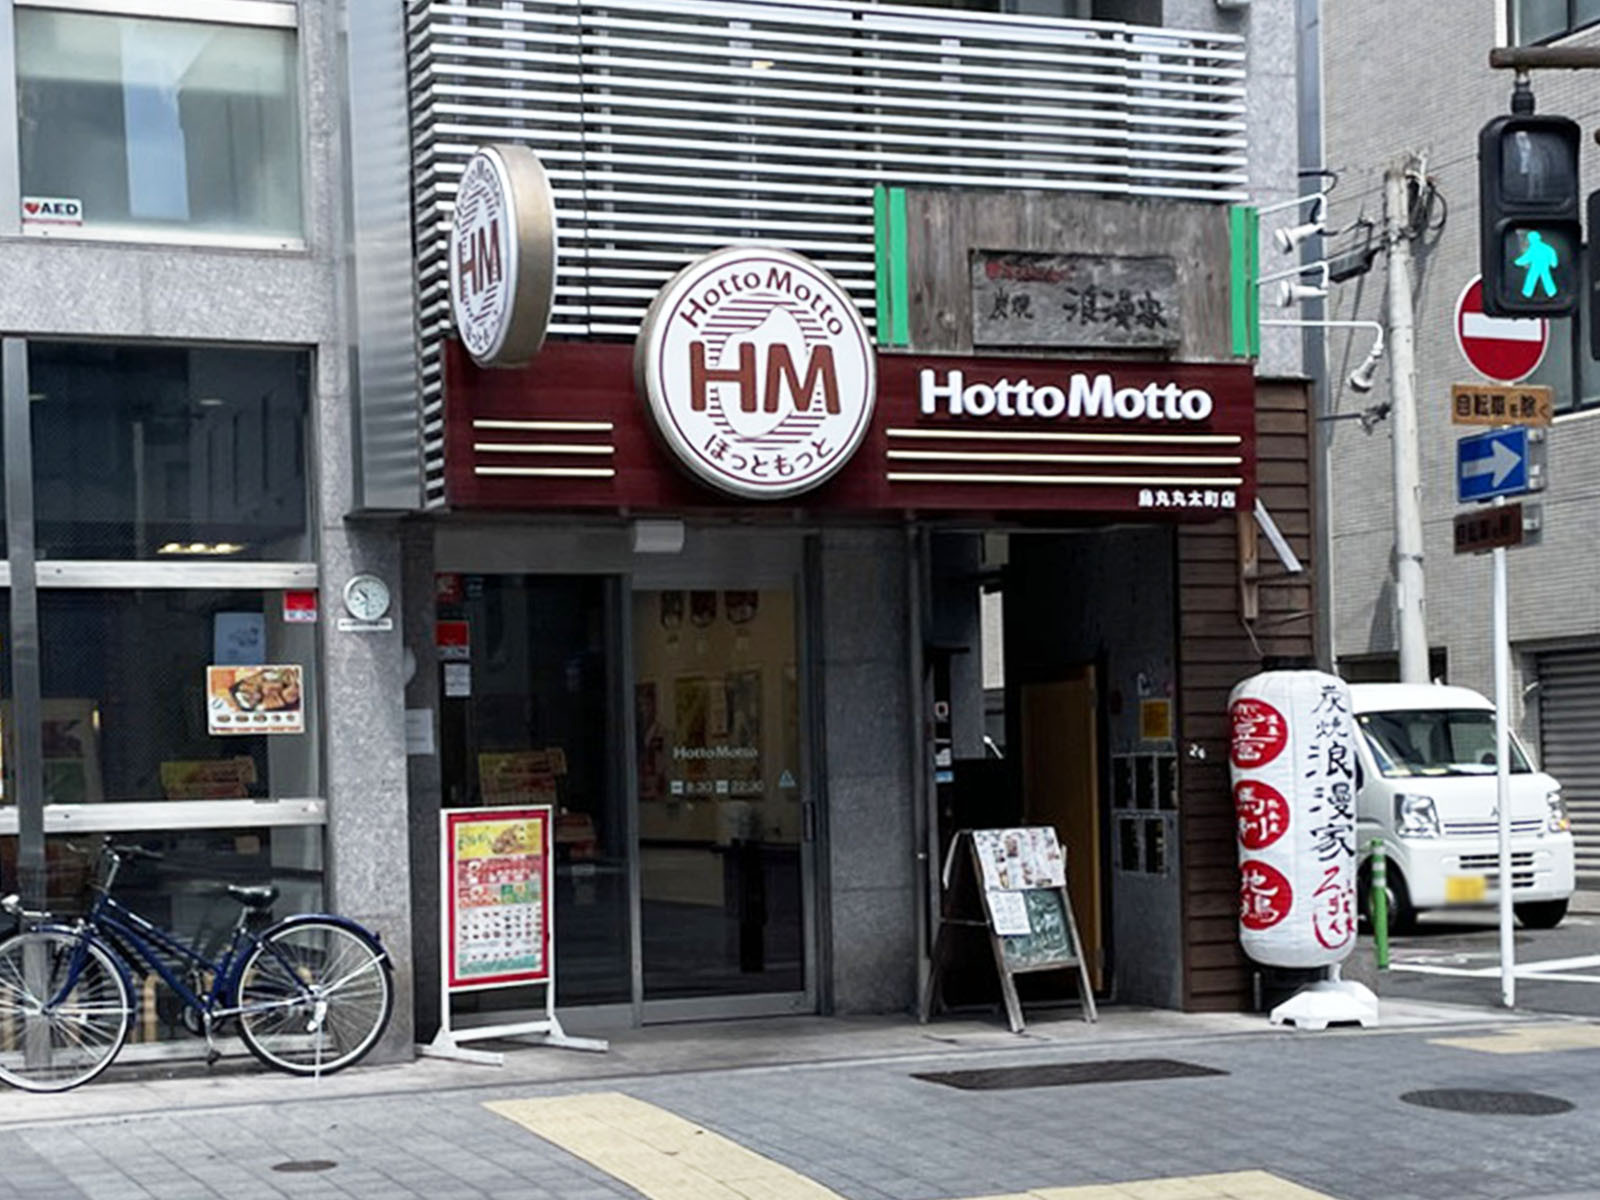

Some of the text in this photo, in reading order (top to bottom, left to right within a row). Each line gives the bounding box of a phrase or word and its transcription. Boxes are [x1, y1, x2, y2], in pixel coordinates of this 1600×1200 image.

[41, 202, 78, 216] AED
[458, 218, 502, 303] HM
[689, 340, 841, 415] HM
[920, 369, 1213, 420] HottoMotto
[704, 434, 833, 477] ほっともっと
